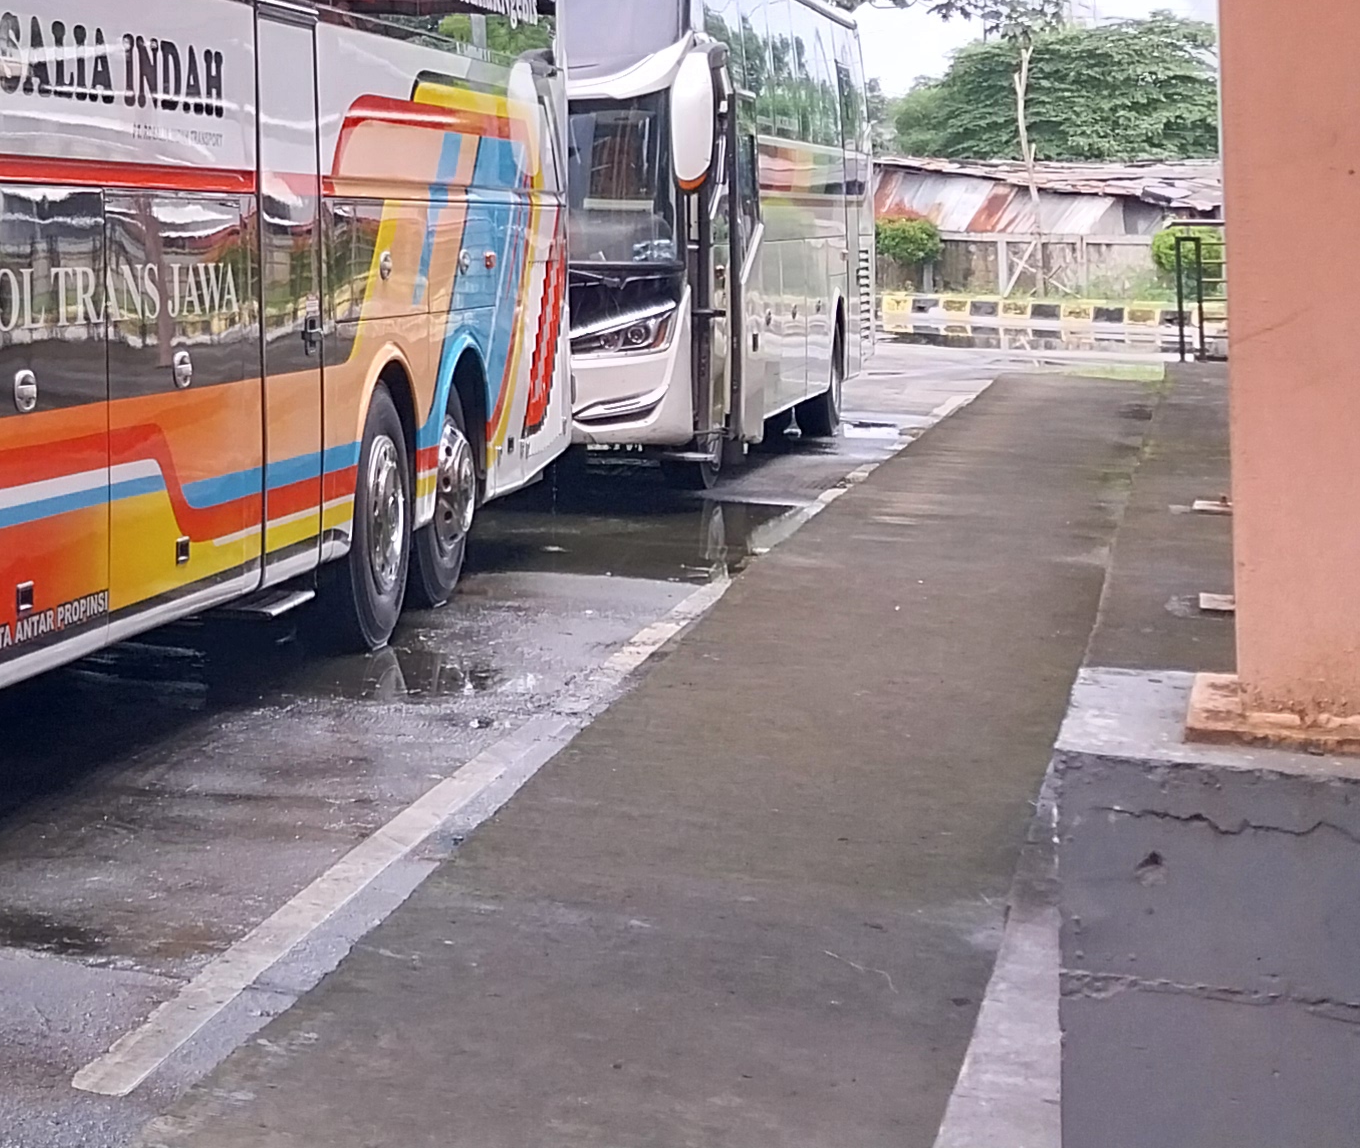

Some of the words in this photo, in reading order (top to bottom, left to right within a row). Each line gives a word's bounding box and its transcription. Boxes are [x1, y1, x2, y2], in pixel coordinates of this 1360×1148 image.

[122, 33, 223, 118] INDAH
[51, 262, 161, 326] TRANS
[168, 262, 240, 318] JAWA
[15, 610, 54, 643] ANTAR
[57, 591, 109, 628] PROPINSI
